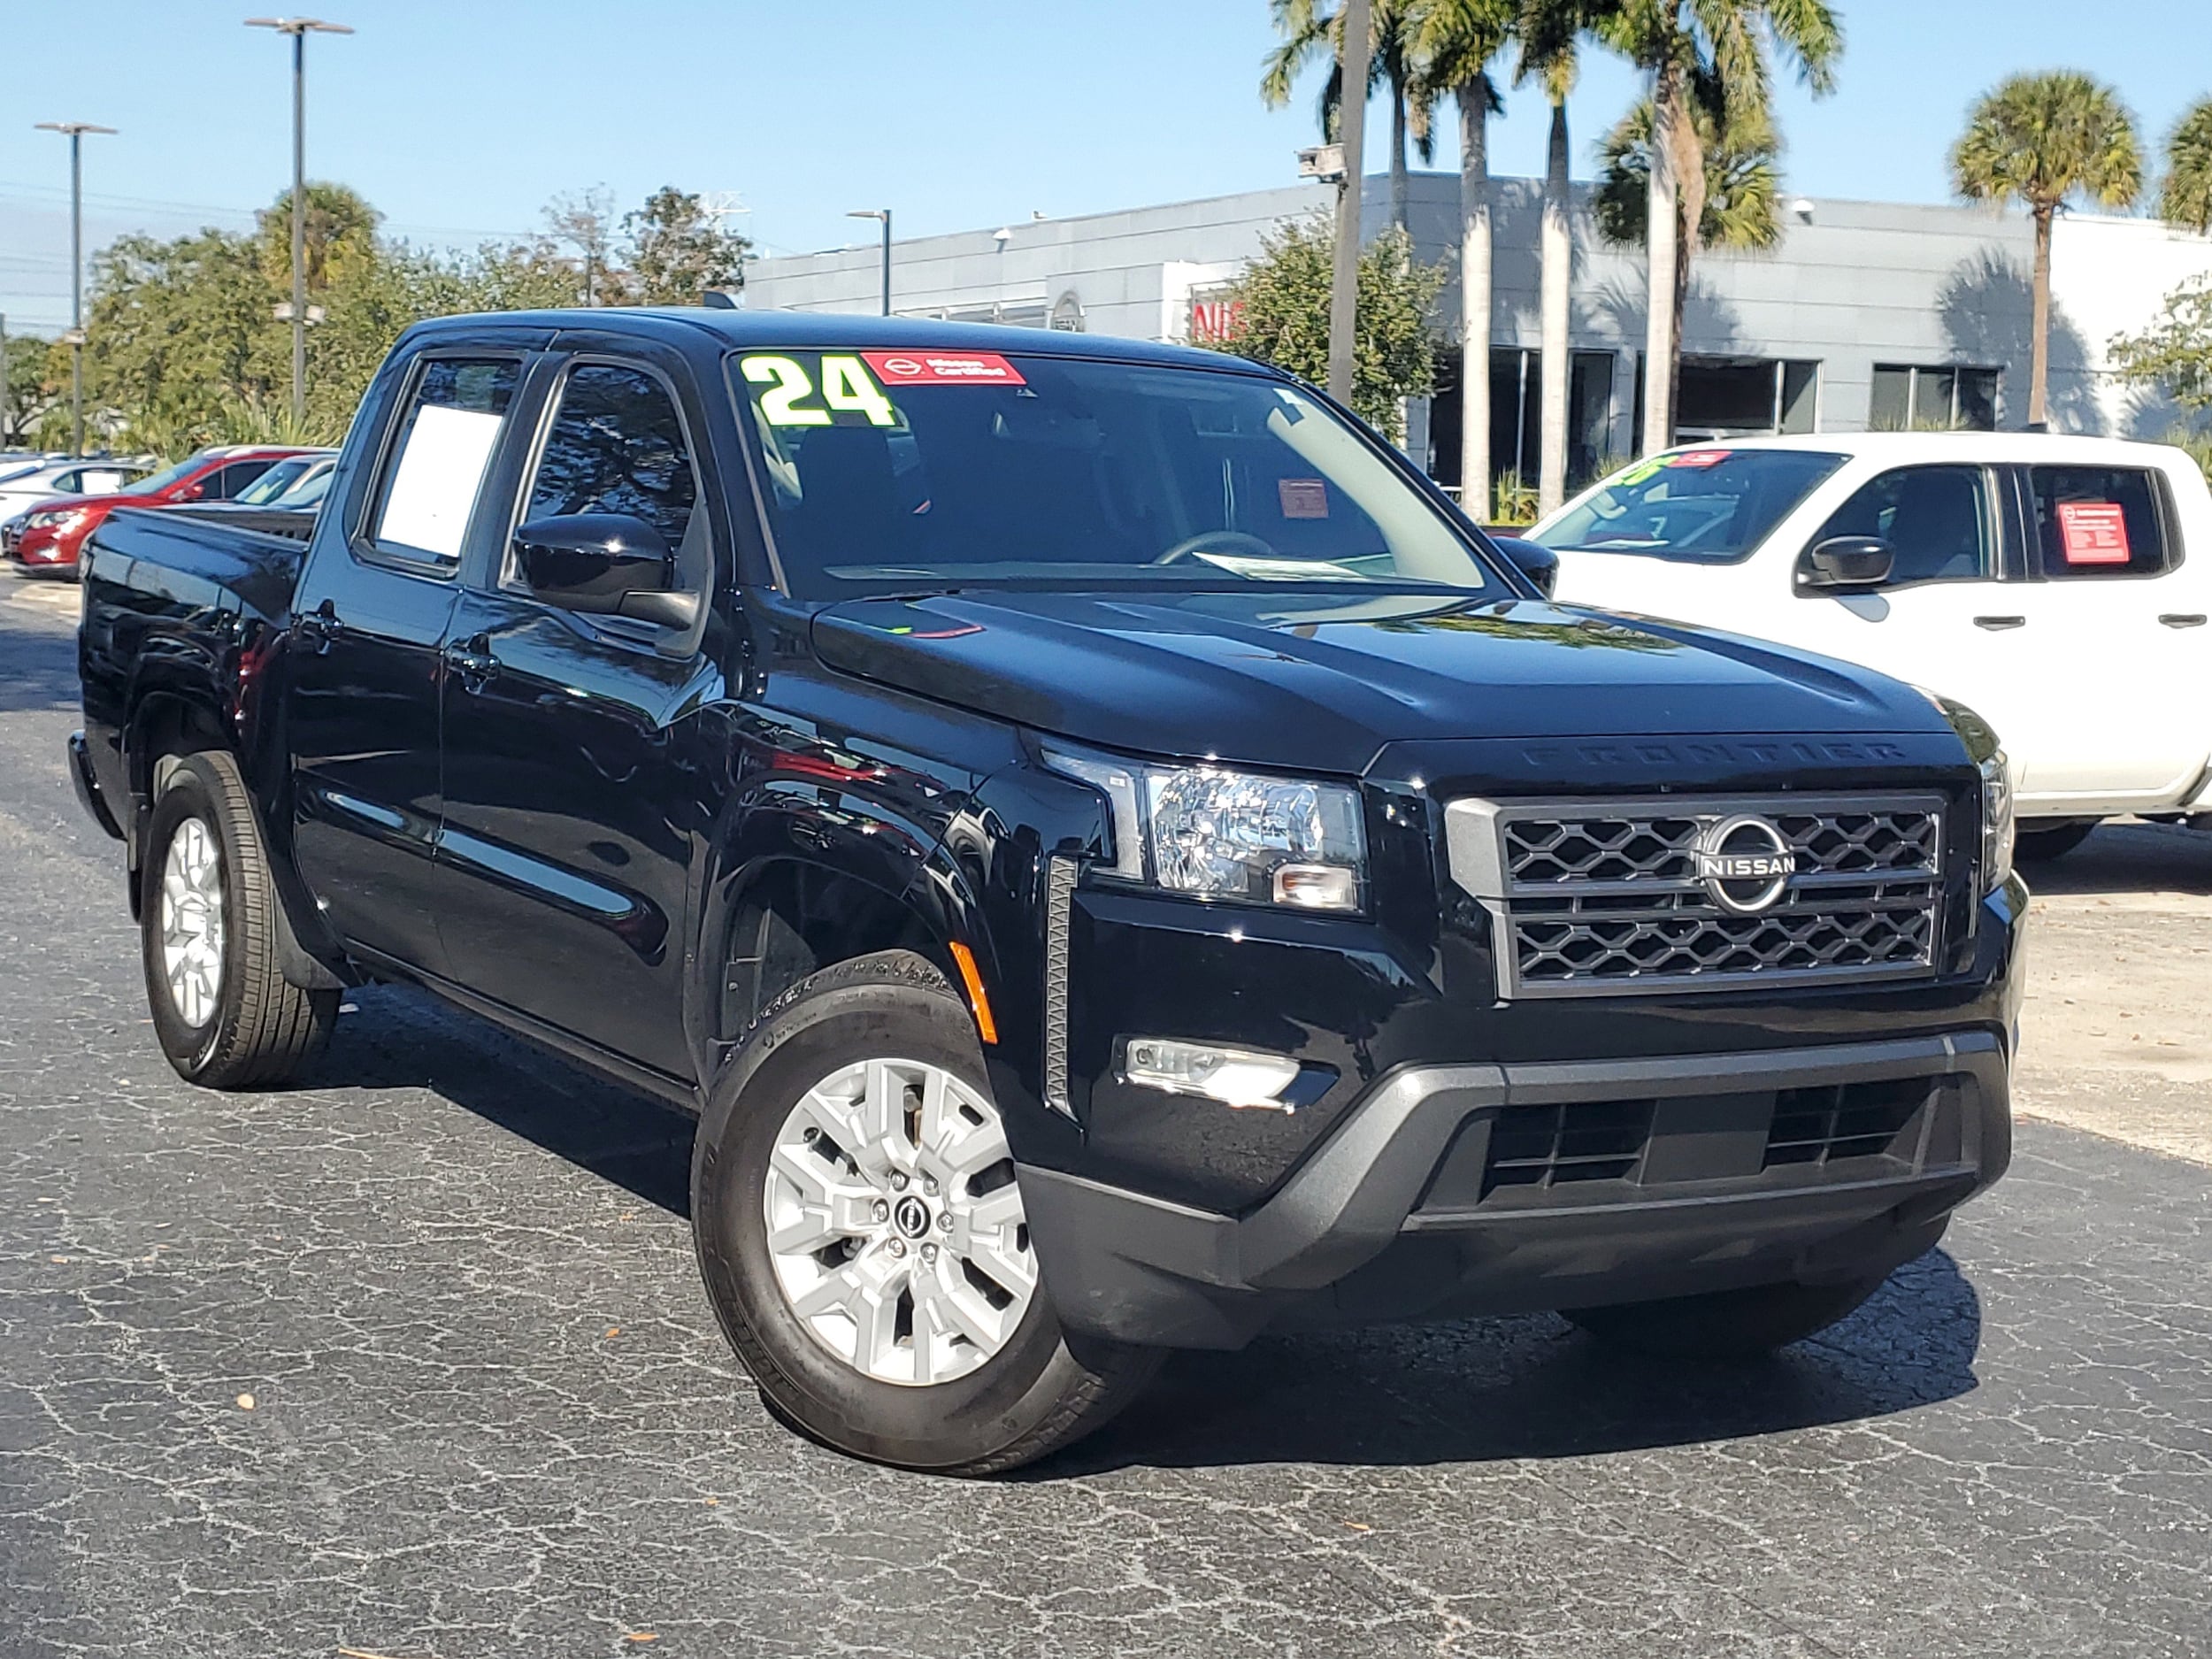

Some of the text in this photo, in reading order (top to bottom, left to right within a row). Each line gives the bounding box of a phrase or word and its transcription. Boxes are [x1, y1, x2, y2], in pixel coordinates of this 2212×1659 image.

[741, 355, 895, 426] 24
[1521, 742, 1905, 765] FRONTIER
[1704, 856, 1795, 875] NISSAN
